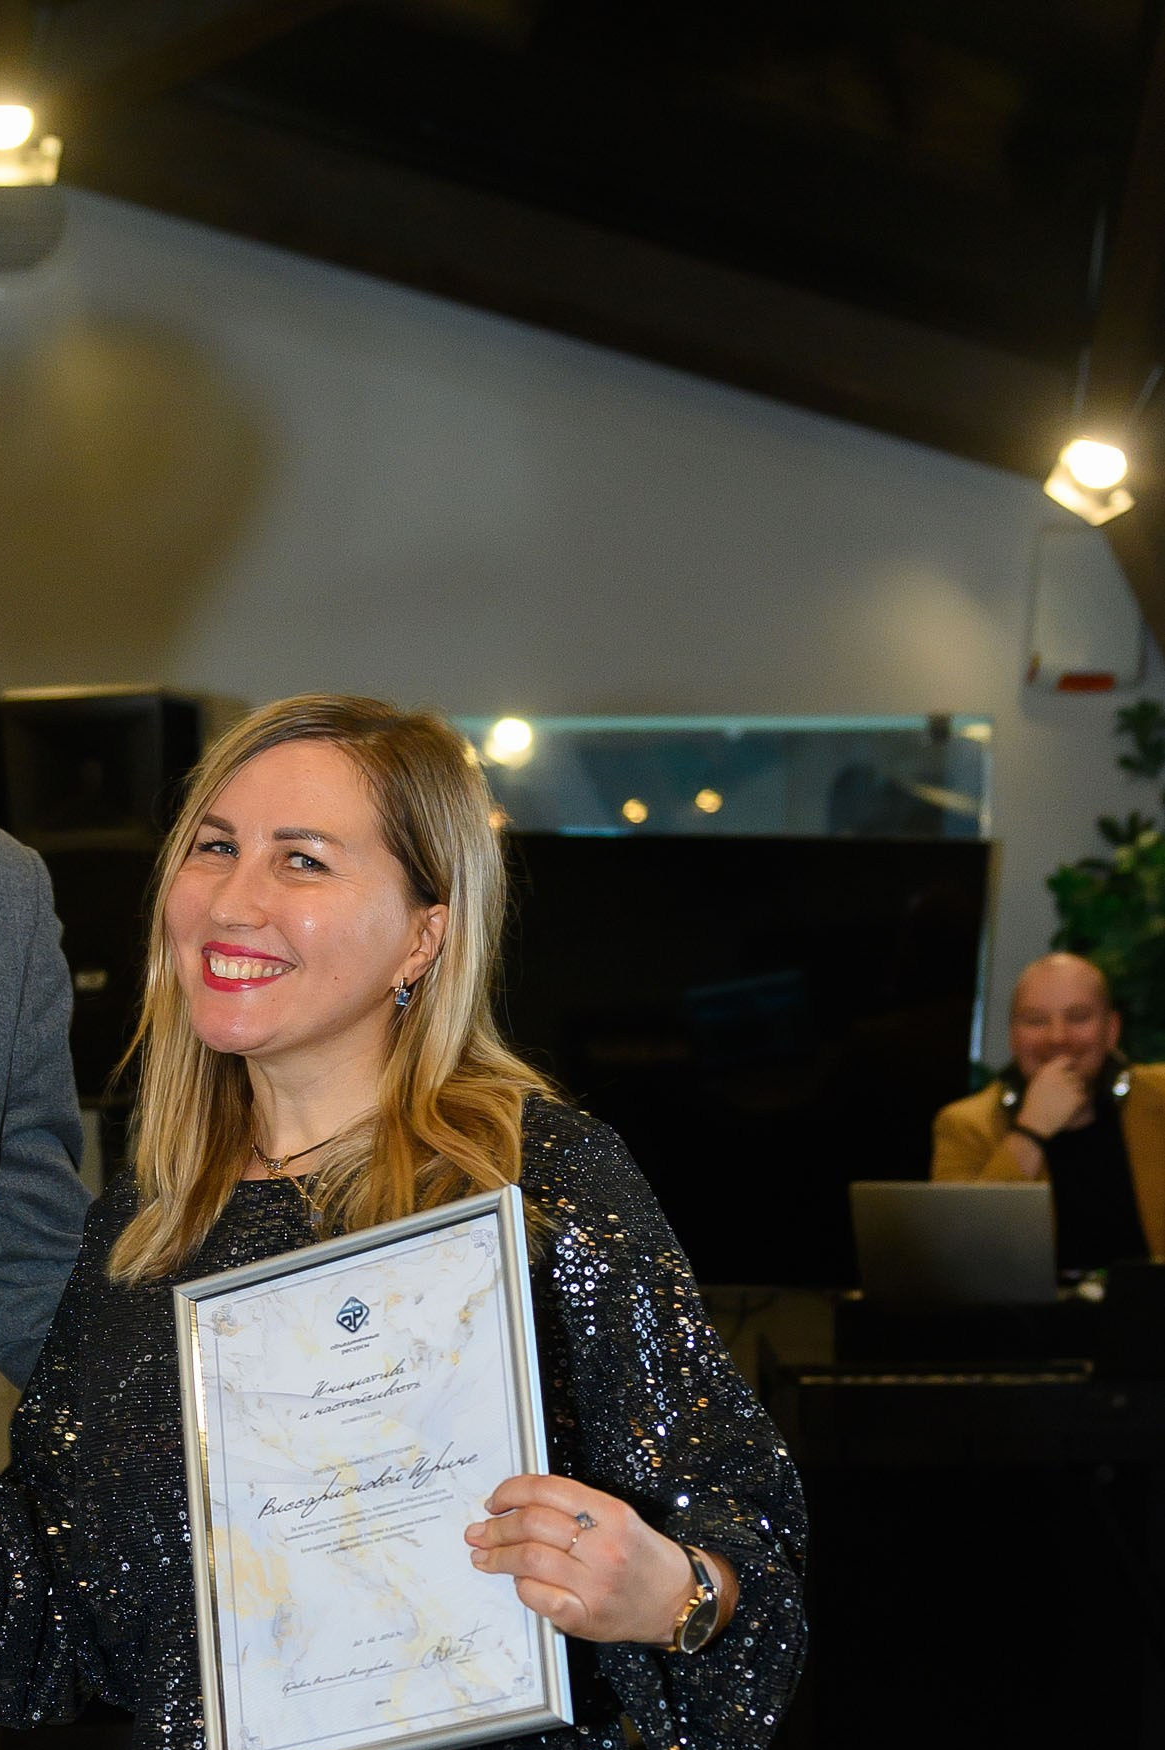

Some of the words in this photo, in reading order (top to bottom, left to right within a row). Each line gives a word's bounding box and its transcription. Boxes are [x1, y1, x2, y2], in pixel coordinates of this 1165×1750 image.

[311, 1358, 406, 1399] Инициатива
[299, 1411, 310, 1420] и
[314, 1379, 422, 1416] настойчивость
[258, 1466, 404, 1519] Виссарионовой
[408, 1441, 478, 1490] Ирине
